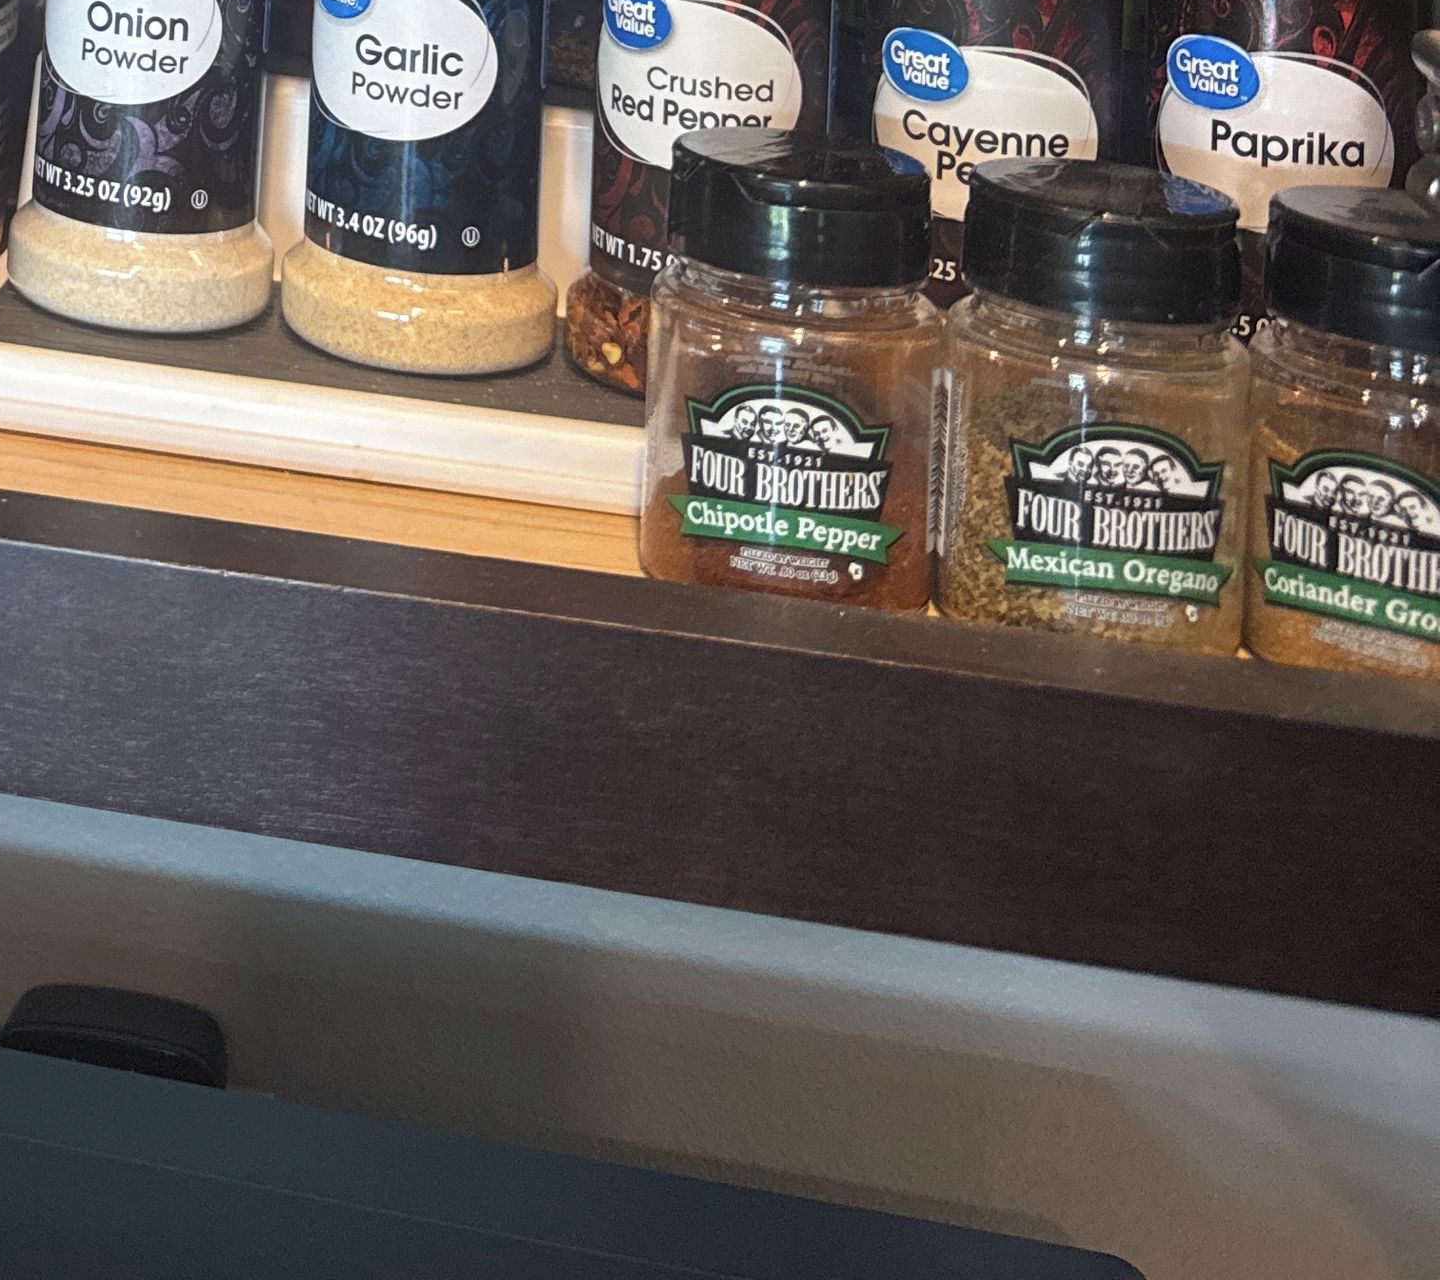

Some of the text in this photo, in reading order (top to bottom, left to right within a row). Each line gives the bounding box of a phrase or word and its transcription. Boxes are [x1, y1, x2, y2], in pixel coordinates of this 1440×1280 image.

[87, 0, 189, 42] Onion
[615, 13, 655, 39] Value
[81, 38, 189, 75] Powder
[355, 33, 464, 76] Garlic
[1176, 48, 1239, 83] Great
[351, 71, 464, 111] Powder
[611, 83, 653, 122] Red
[647, 65, 774, 103] Crushed
[1188, 73, 1239, 98] Value
[902, 109, 1068, 158] Cayenne
[1210, 119, 1365, 169] Paprika
[63, 170, 171, 213] 3.25 OZ (92g)
[336, 208, 437, 250] 3.4 OZ (96g)
[691, 444, 884, 511] FOUR BROTHERS
[687, 501, 882, 552] Chipotle Pepper
[1017, 487, 1216, 553] FOUR BROTHERS
[1006, 546, 1219, 595] Mexican Oregano
[1264, 569, 1376, 616] Coriander
